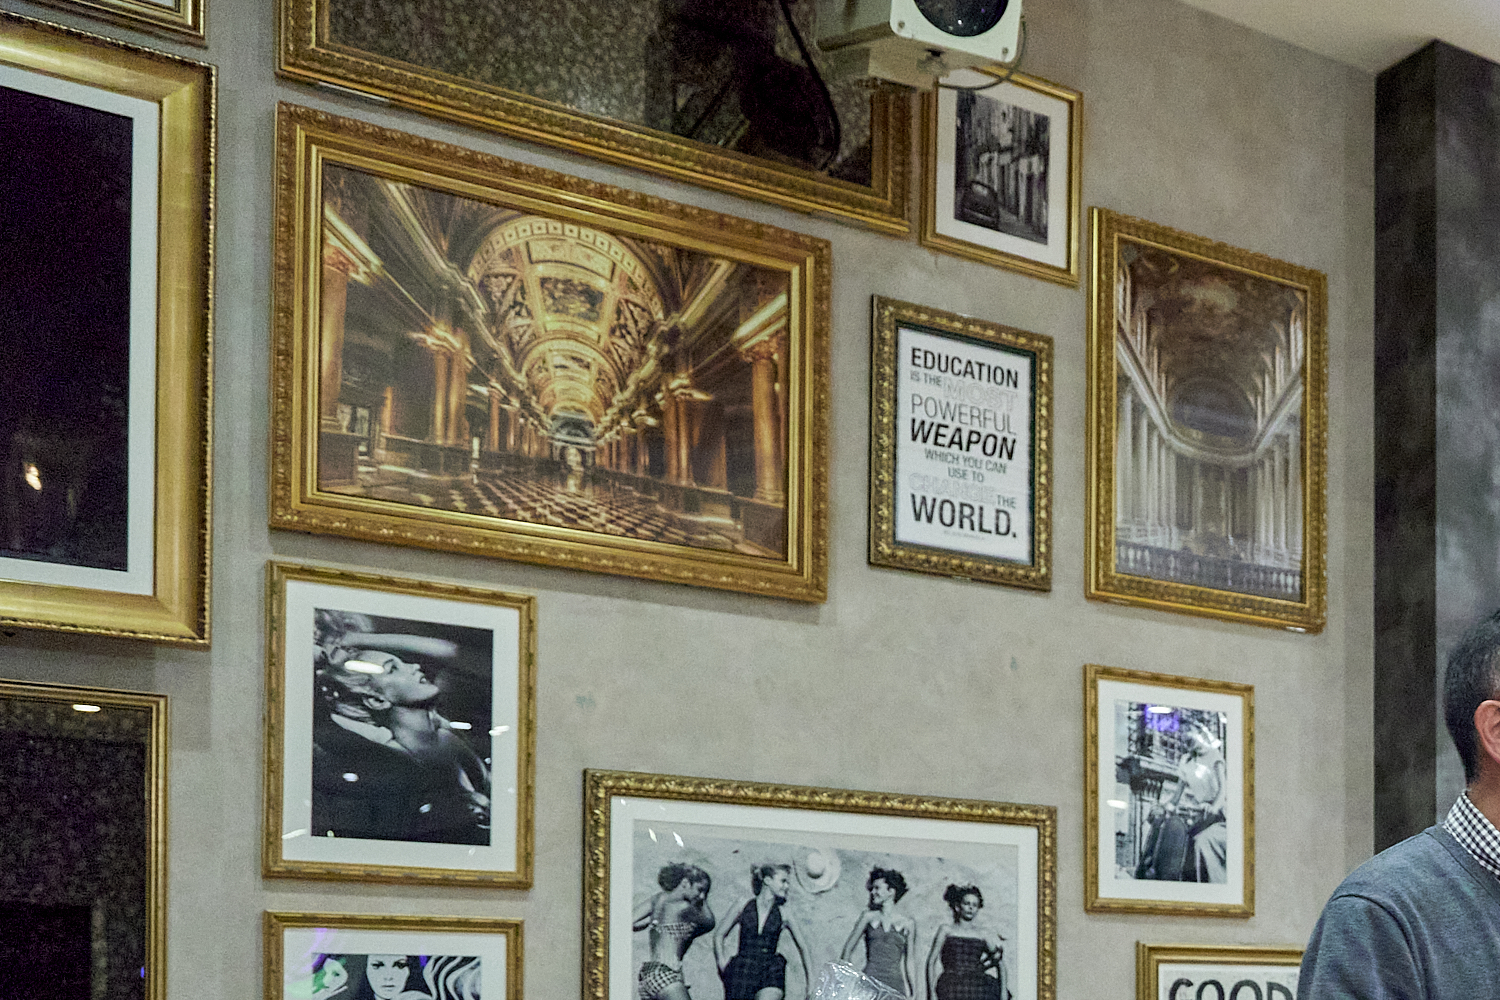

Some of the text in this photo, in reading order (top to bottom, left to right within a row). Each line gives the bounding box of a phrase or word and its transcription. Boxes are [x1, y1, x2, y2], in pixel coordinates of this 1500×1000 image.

[910, 370, 920, 382] IS
[924, 372, 942, 386] THE
[911, 347, 1018, 389] EDUCATION
[911, 393, 1016, 436] POWERFUL
[911, 417, 1016, 461] WEAPON
[924, 447, 1007, 474] WHICH YOU CAN
[948, 467, 985, 483] USE TO
[910, 493, 1017, 538] WORLD.
[997, 494, 1016, 509] THE
